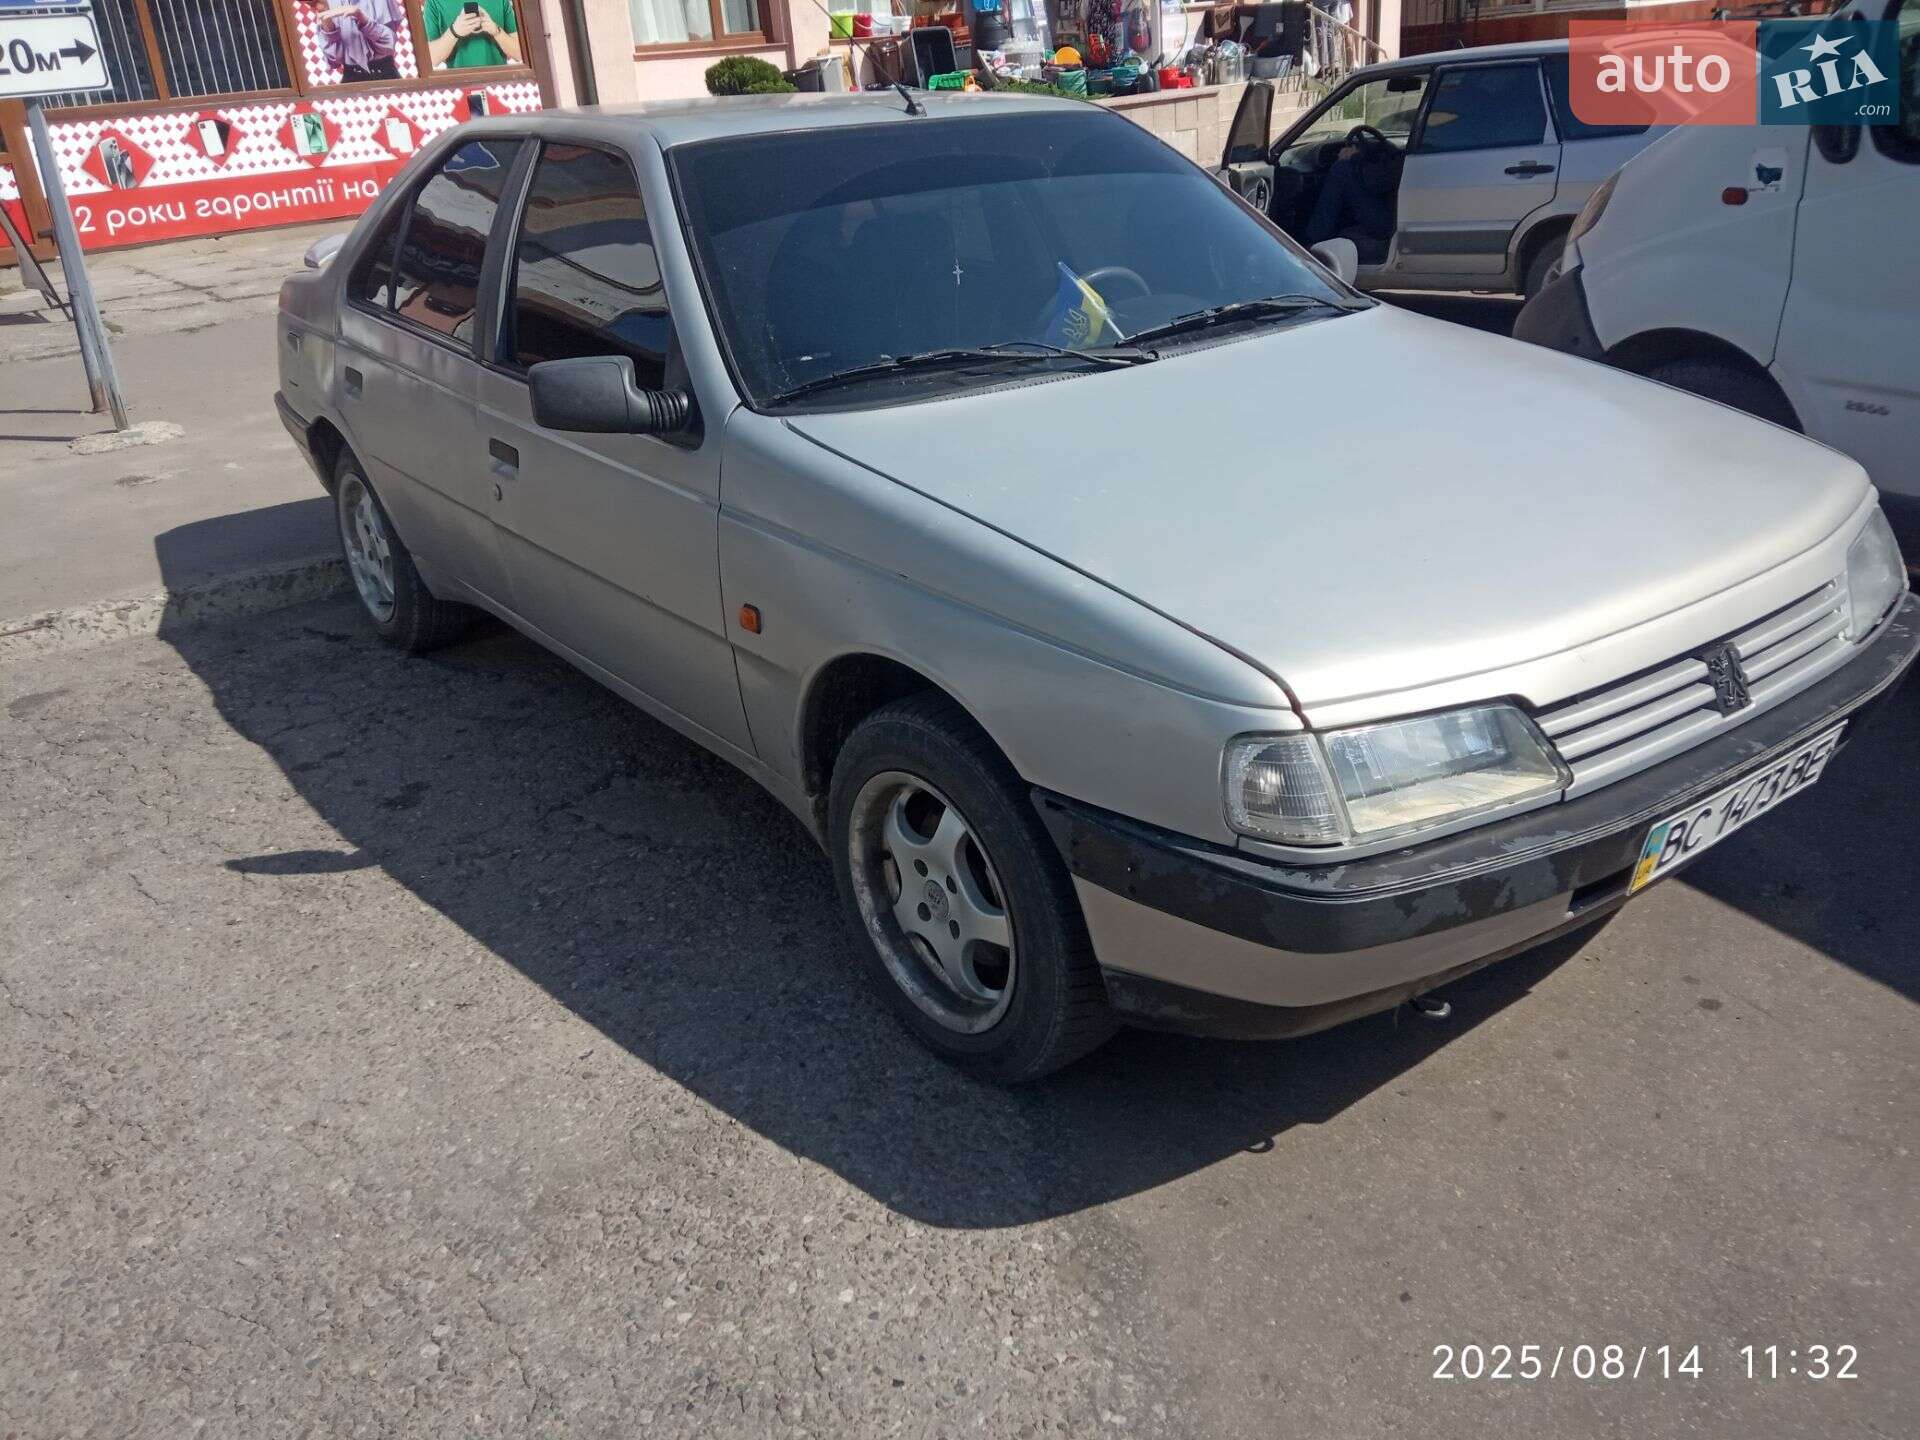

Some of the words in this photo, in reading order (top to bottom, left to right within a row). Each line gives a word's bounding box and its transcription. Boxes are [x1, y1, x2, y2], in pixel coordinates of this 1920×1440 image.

[74, 205, 96, 233] 2
[105, 202, 186, 236] роки
[195, 178, 335, 220] гарантії
[343, 179, 380, 200] на
